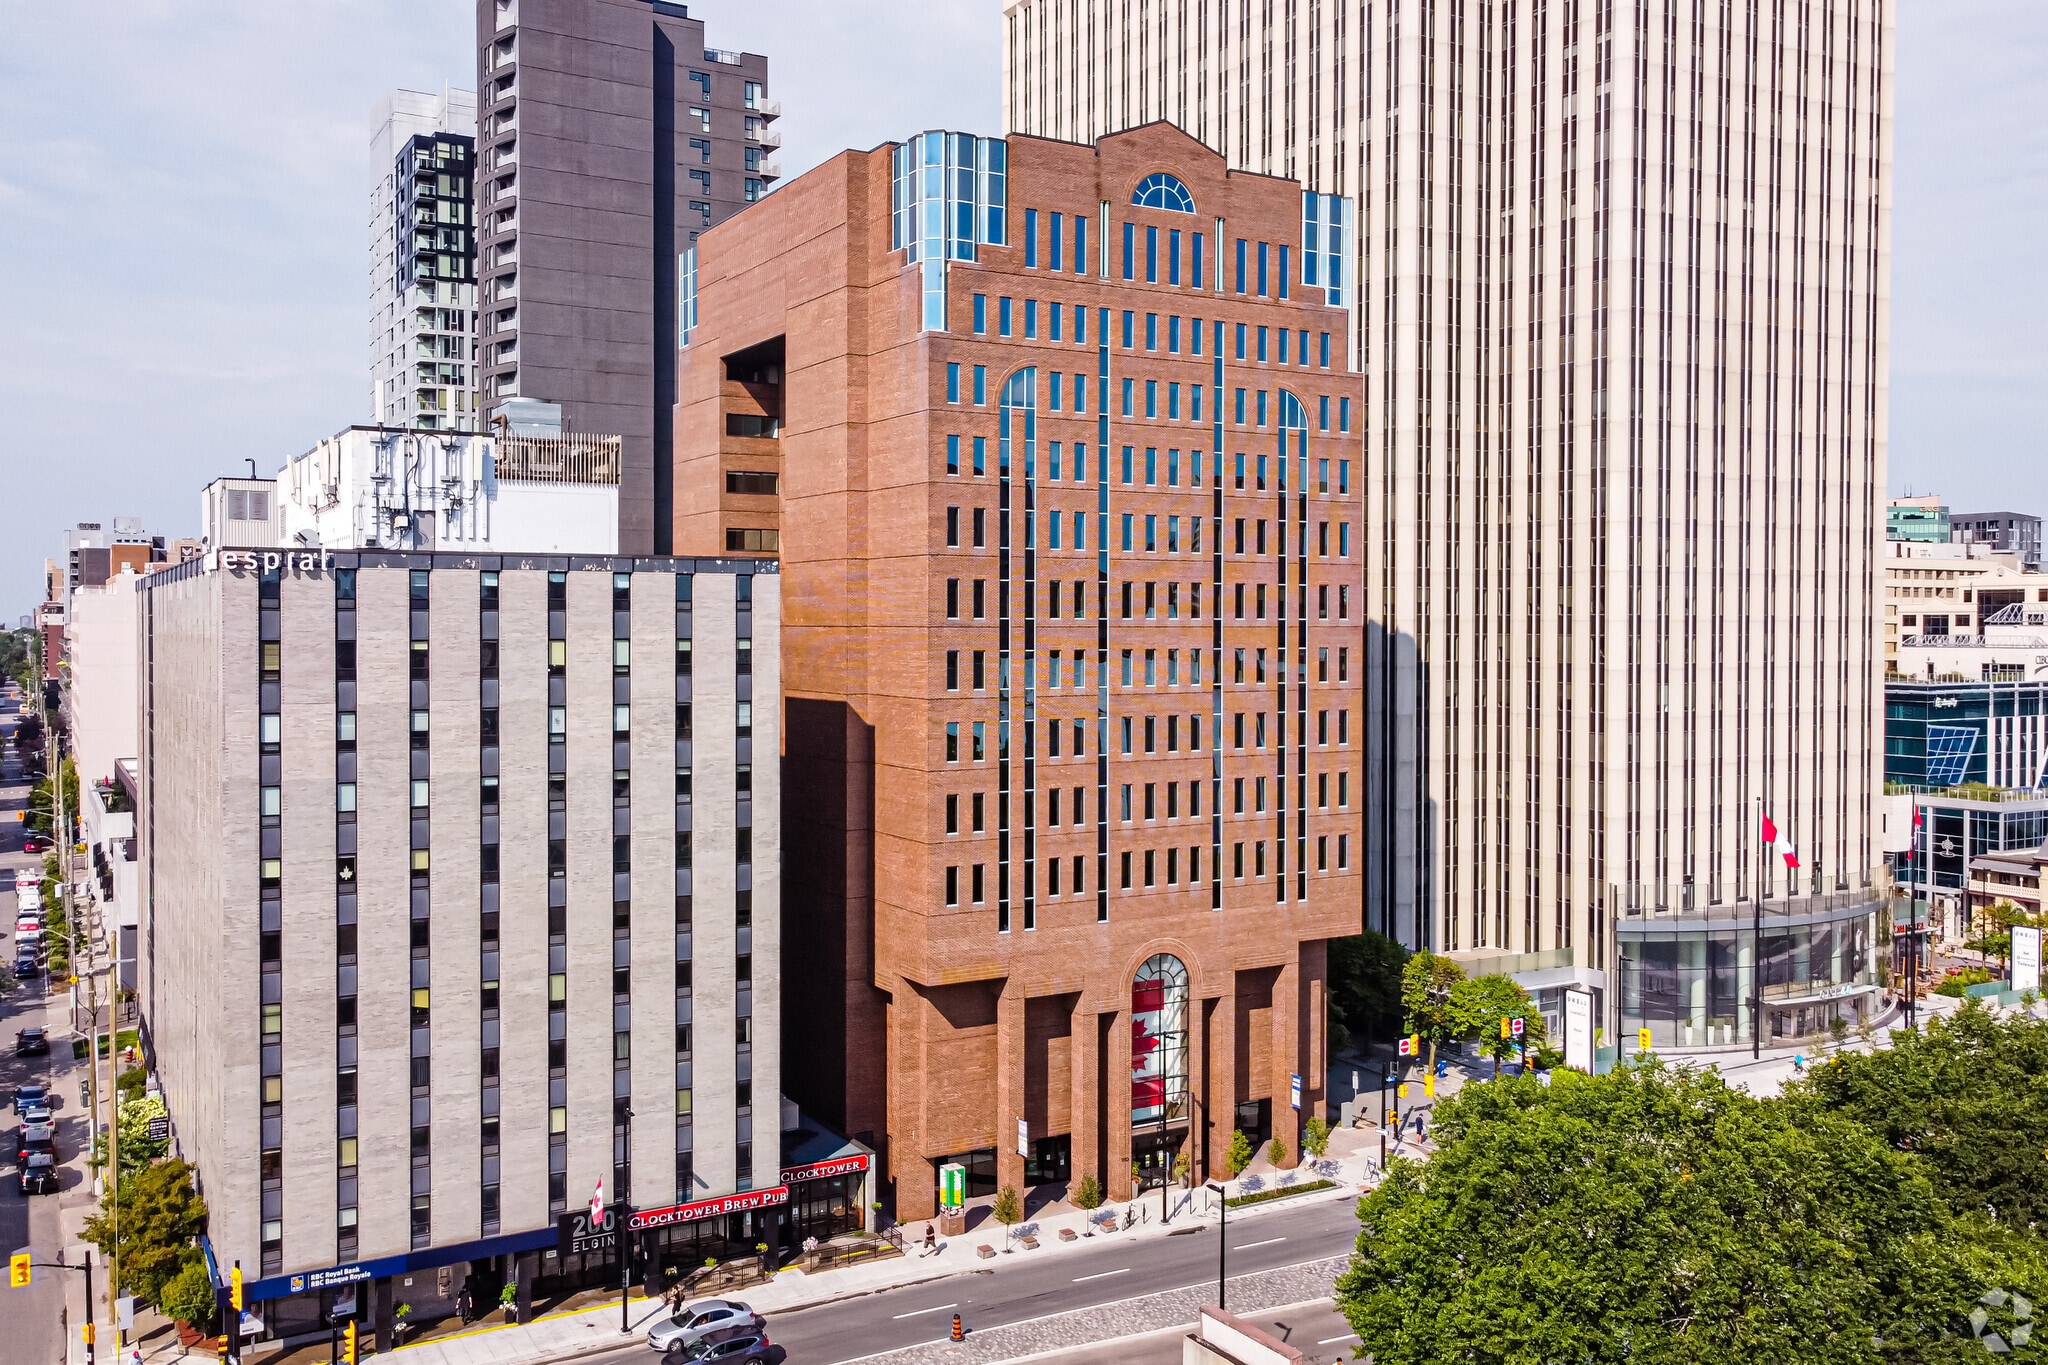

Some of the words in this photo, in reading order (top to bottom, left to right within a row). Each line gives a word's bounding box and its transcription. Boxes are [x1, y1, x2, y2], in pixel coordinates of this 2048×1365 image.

[781, 1161, 860, 1182] CLOCKTOWER
[629, 1204, 720, 1228] CLOCKTOWER
[724, 1193, 760, 1211] BREW
[763, 1192, 788, 1205] PUB
[572, 1210, 615, 1238] 200
[572, 1235, 615, 1253] ELGIN
[310, 1272, 324, 1281] RBC
[325, 1268, 343, 1279] Royal
[344, 1266, 360, 1275] Bank
[310, 1279, 324, 1288] RBC
[325, 1275, 349, 1286] Banque
[349, 1271, 371, 1281] Royale
